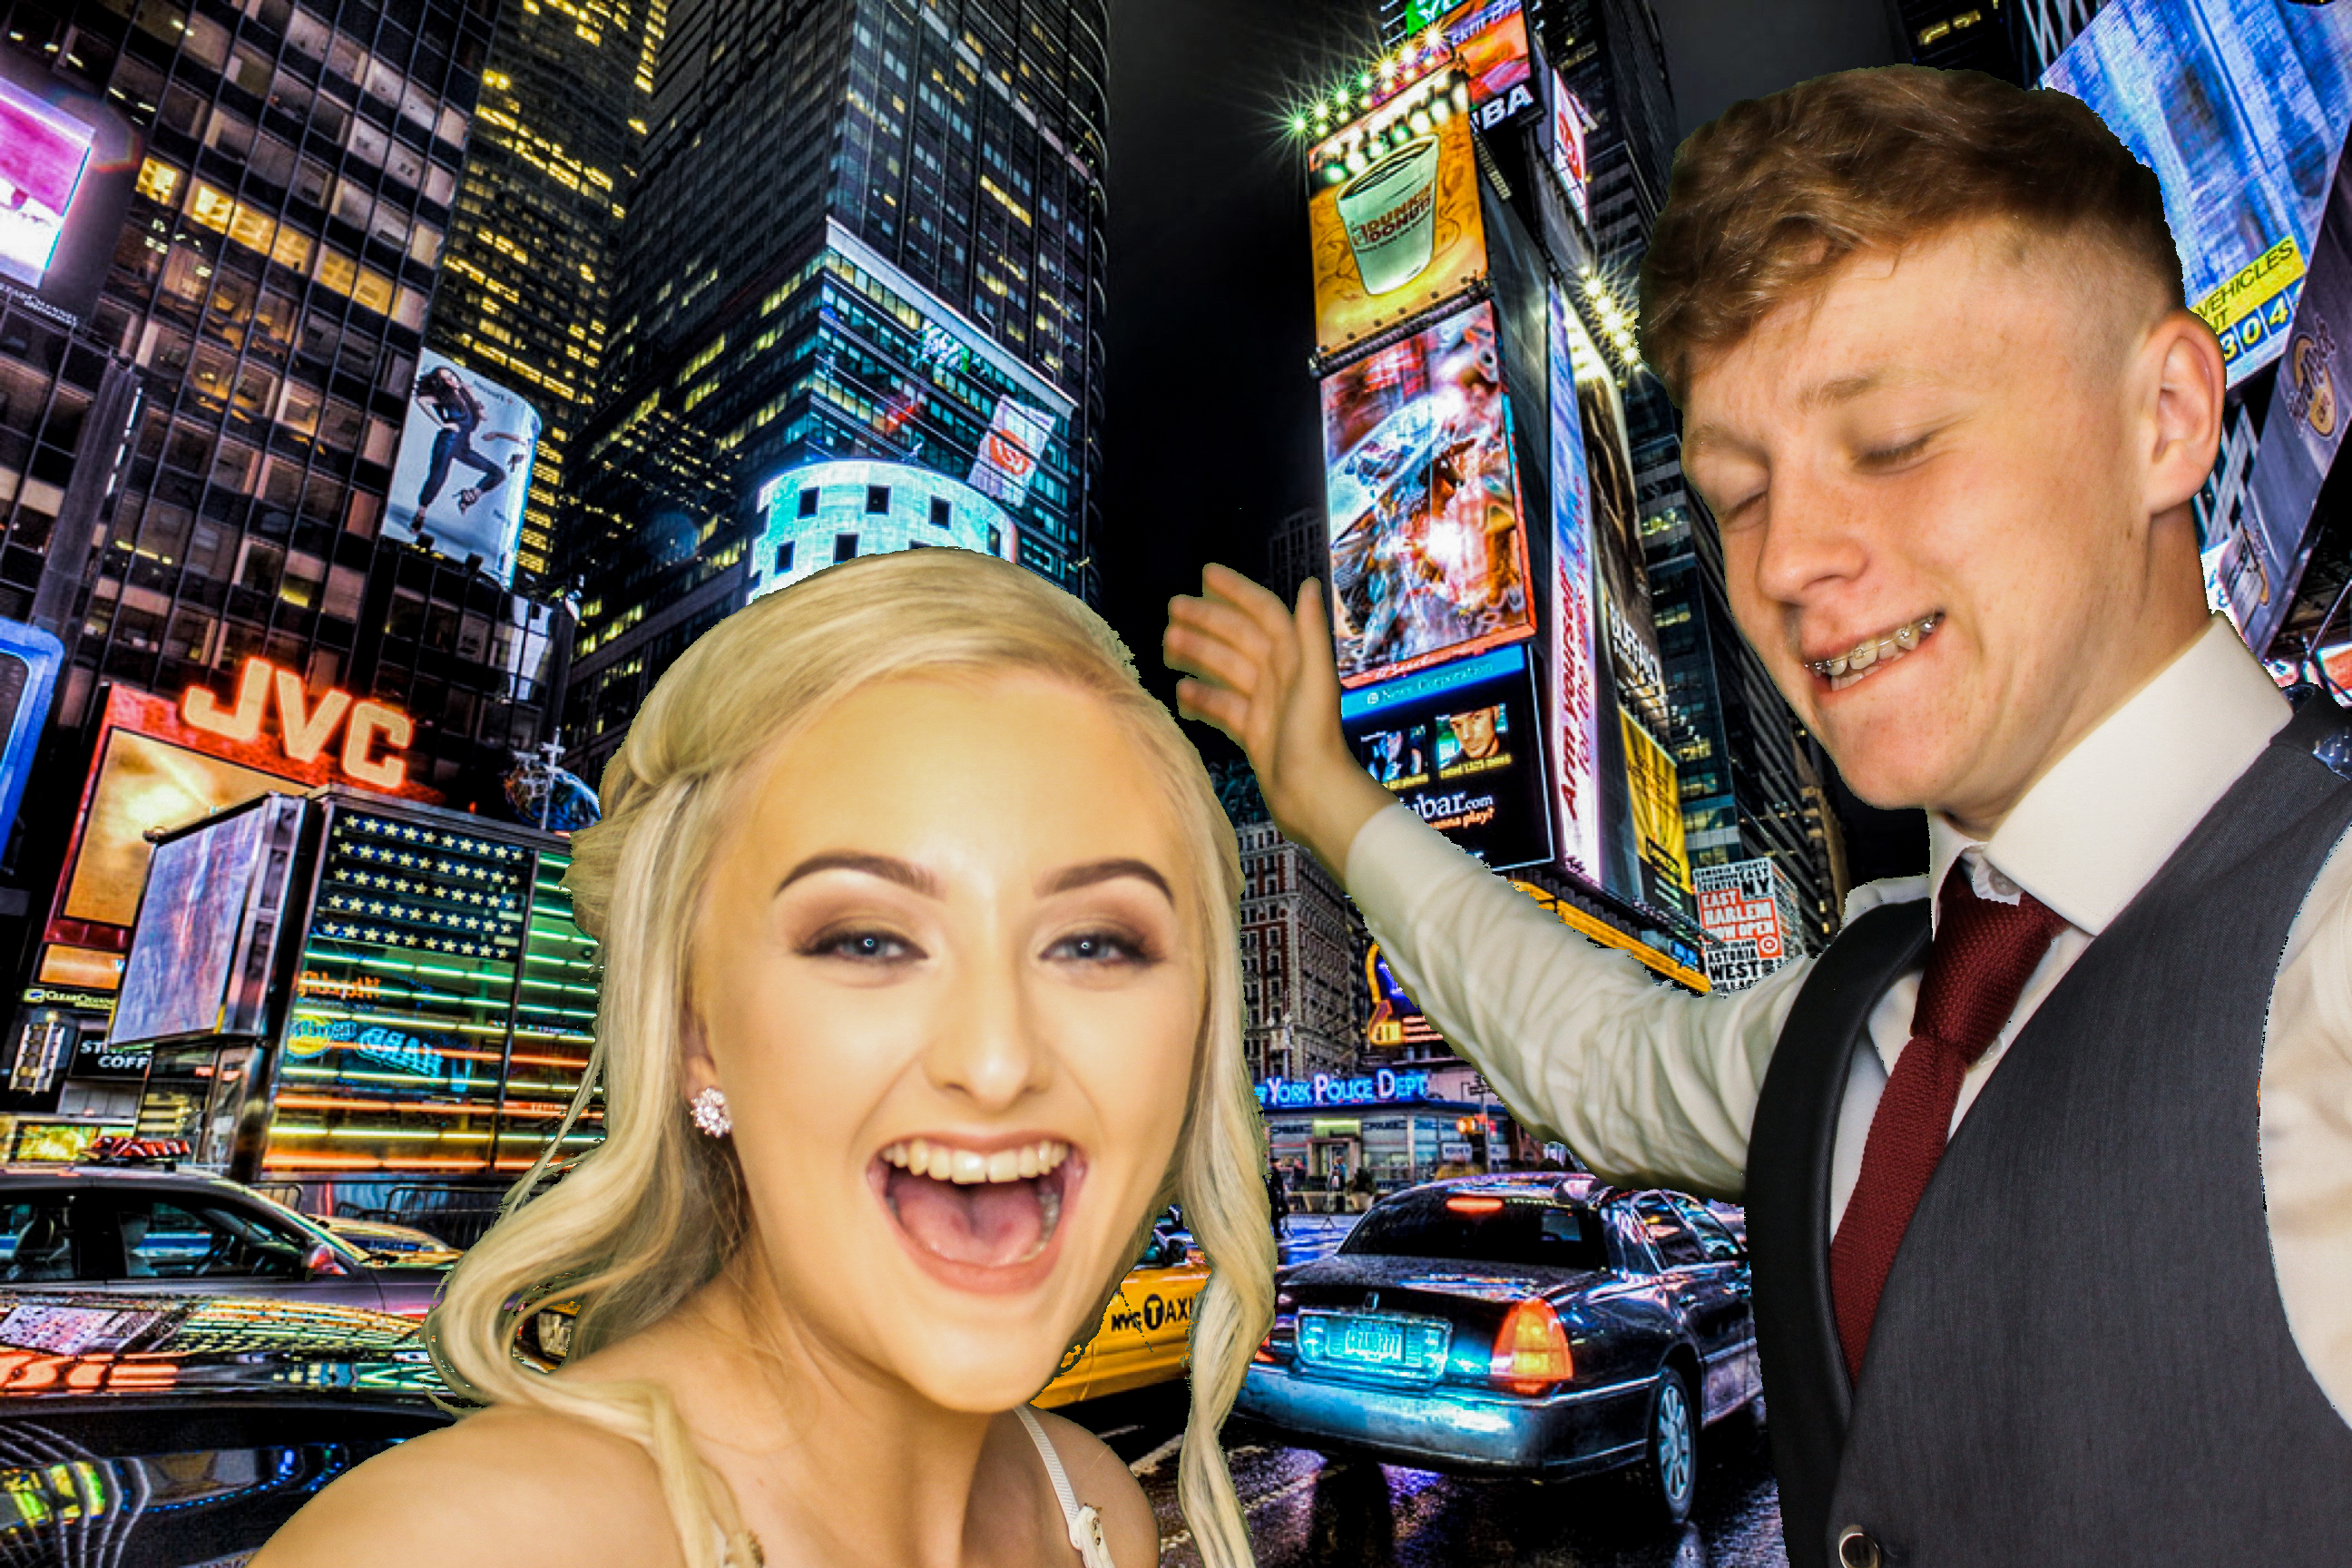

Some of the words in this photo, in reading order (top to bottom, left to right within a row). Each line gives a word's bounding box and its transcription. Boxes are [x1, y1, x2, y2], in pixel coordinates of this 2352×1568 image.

[2196, 239, 2294, 318] VEHICLES
[181, 655, 414, 789] JVC
[1560, 725, 1578, 821] Arm
[1702, 890, 1736, 907] EAST
[1703, 901, 1772, 926] HARLEM
[1739, 919, 1774, 937] OPEN
[1709, 961, 1759, 981] WEST
[1267, 1076, 1311, 1103] YORK
[1314, 1073, 1374, 1102] POLICE
[1376, 1068, 1429, 1099] DEPT
[1144, 1293, 1195, 1330] TAXI
